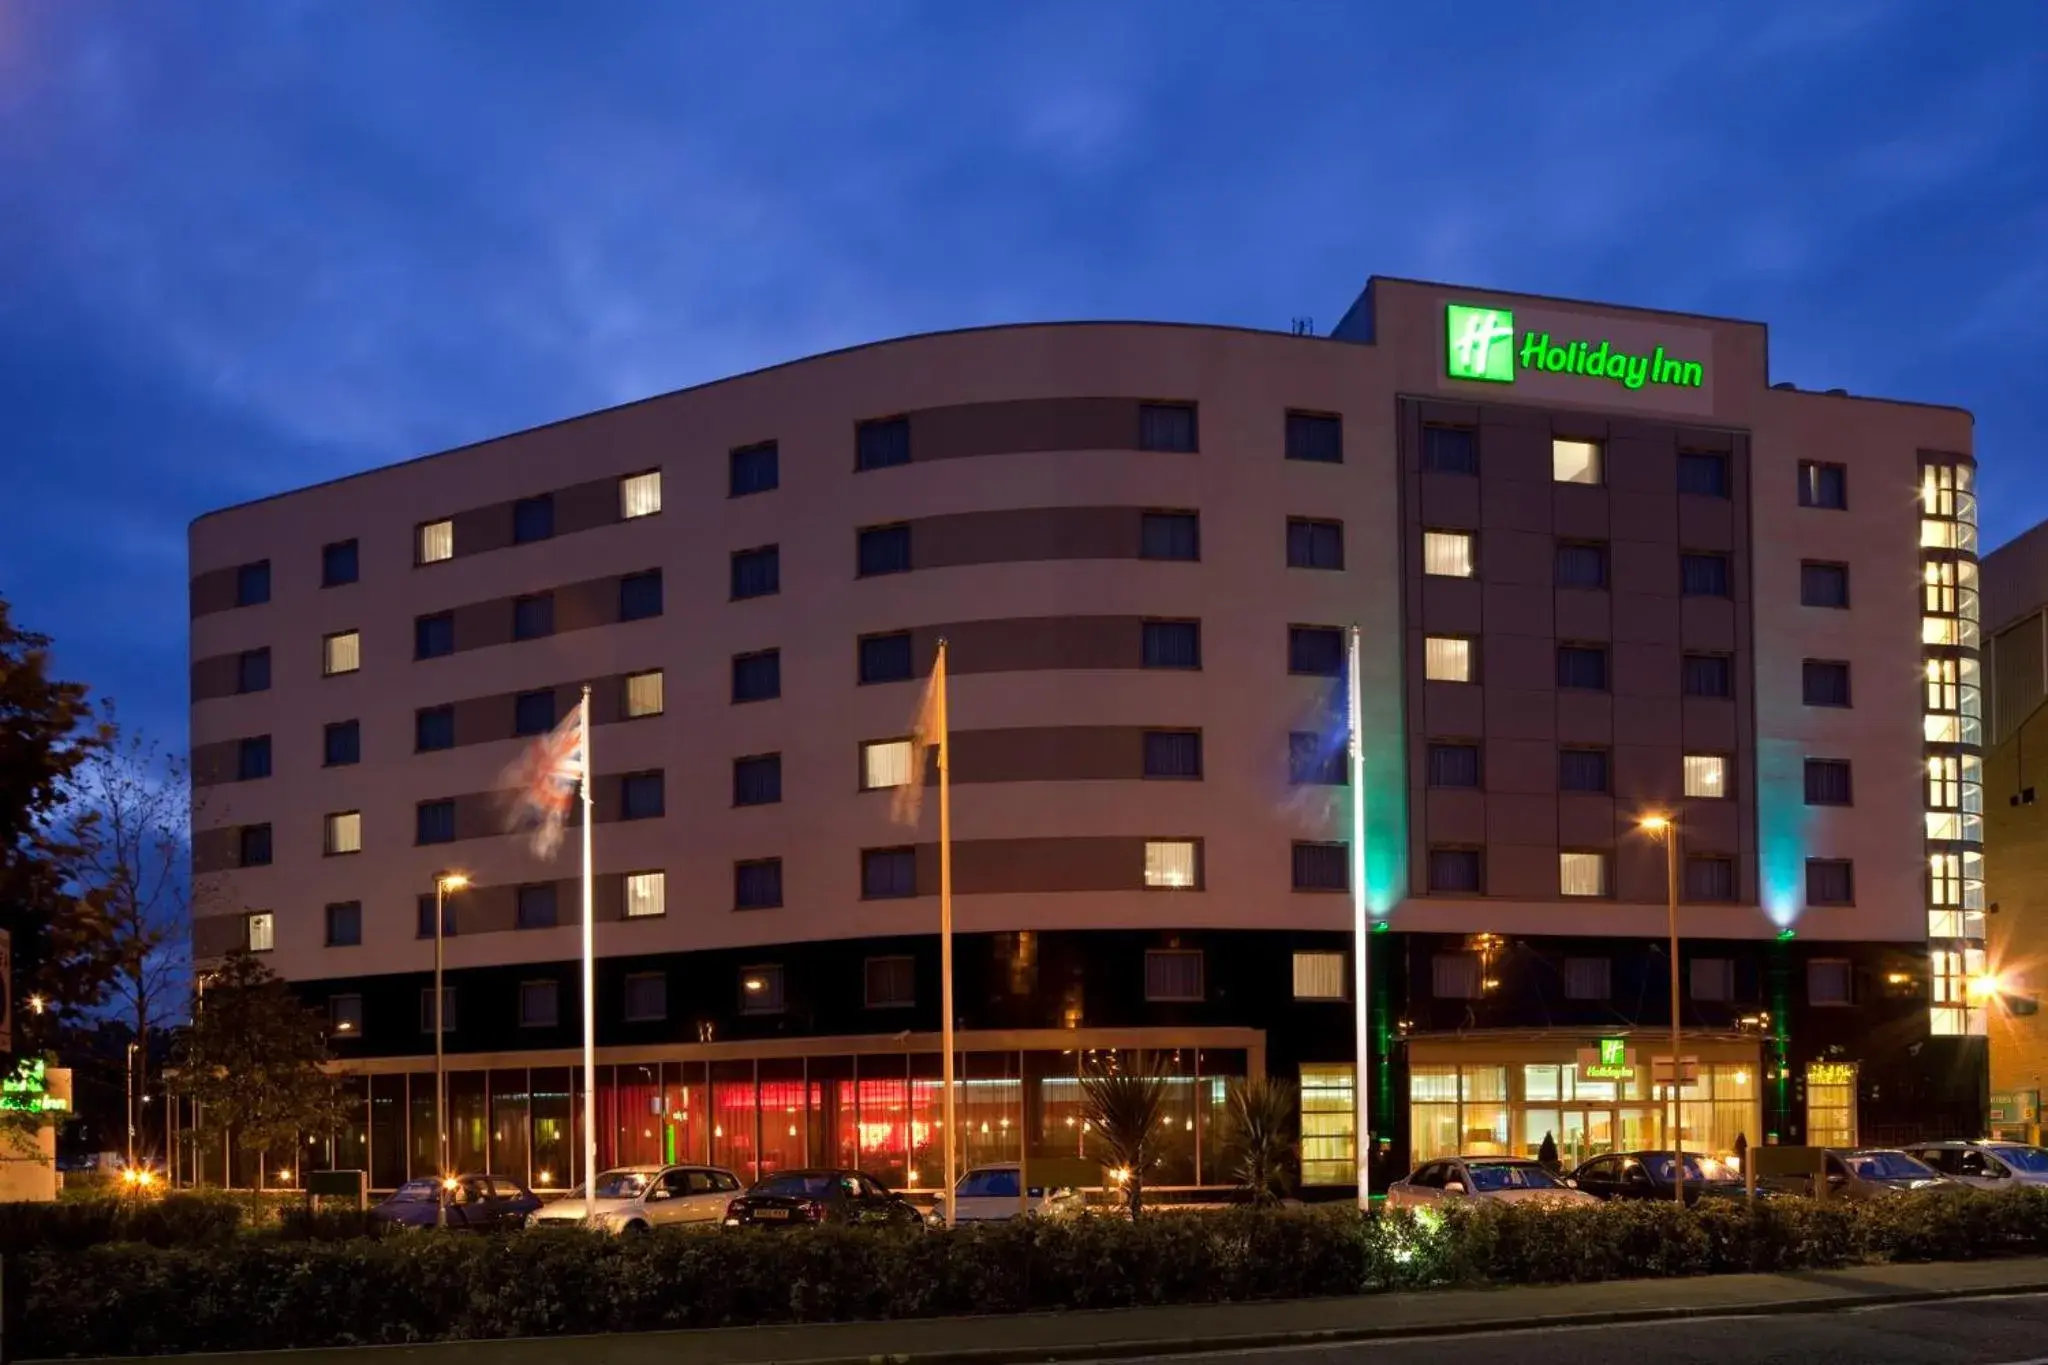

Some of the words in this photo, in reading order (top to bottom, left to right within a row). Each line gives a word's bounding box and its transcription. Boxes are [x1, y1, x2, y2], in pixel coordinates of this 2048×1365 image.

[1519, 331, 1649, 389] Holiday
[1650, 346, 1704, 387] Inn
[1586, 1065, 1620, 1079] Holiday
